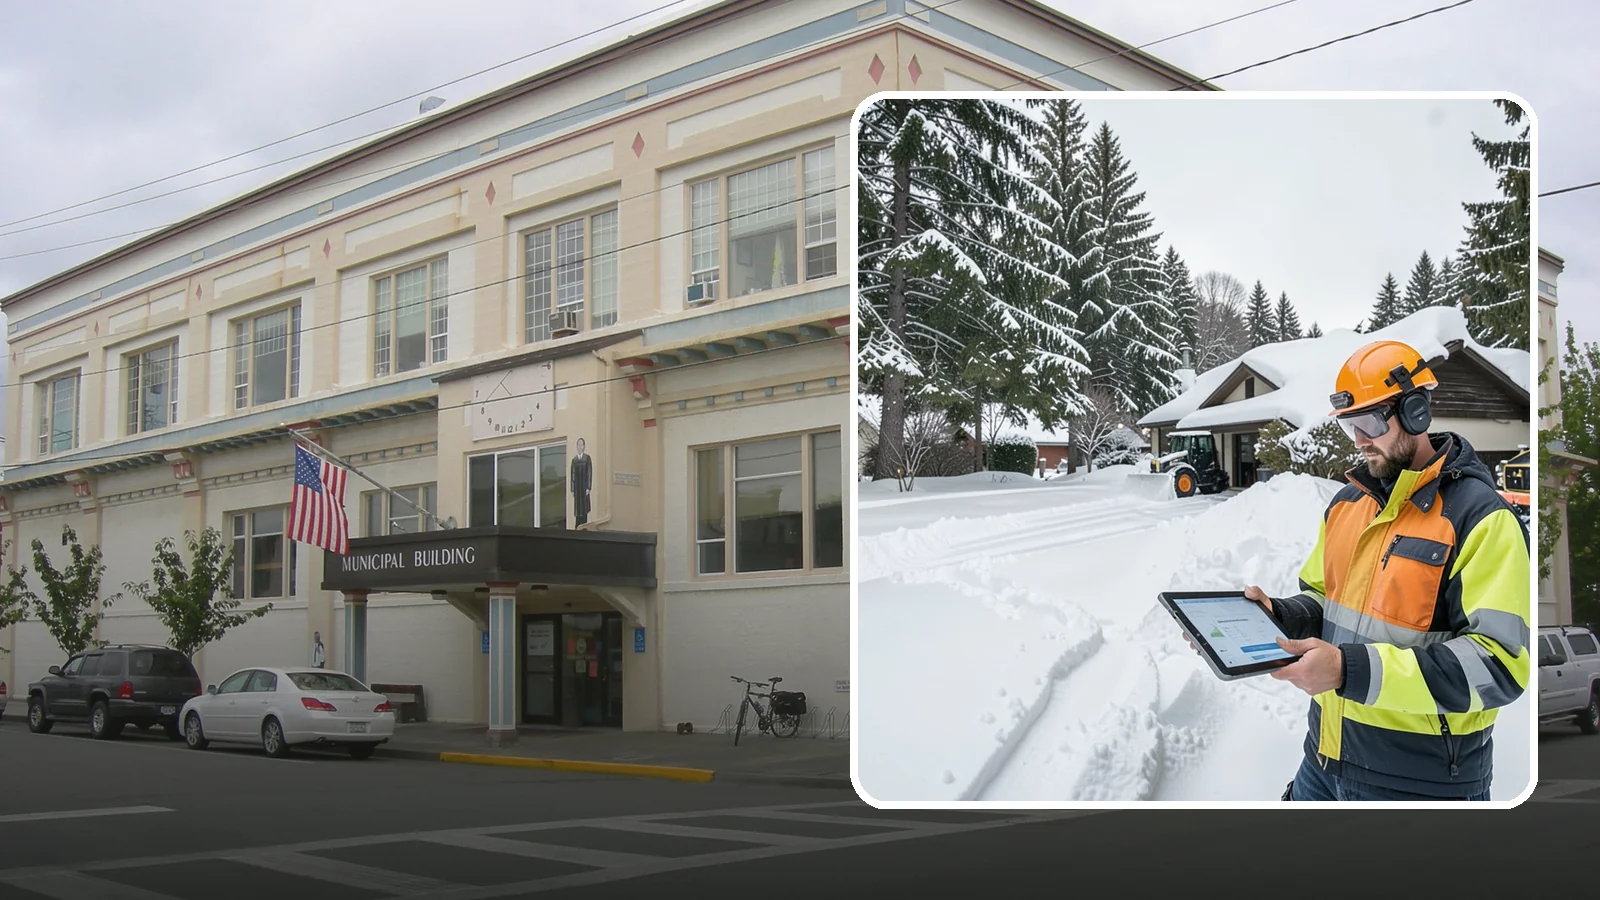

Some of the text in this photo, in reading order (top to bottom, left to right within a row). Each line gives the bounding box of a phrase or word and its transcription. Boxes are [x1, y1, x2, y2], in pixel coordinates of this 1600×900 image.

[536, 402, 540, 410] 4
[481, 407, 485, 415] 8
[488, 418, 492, 426] 9
[529, 414, 533, 422] 3
[495, 424, 500, 432] 10
[502, 425, 506, 433] 11
[507, 425, 513, 433] 12
[521, 420, 525, 428] 2
[342, 546, 475, 572] MUNICIPAL BUILDING
